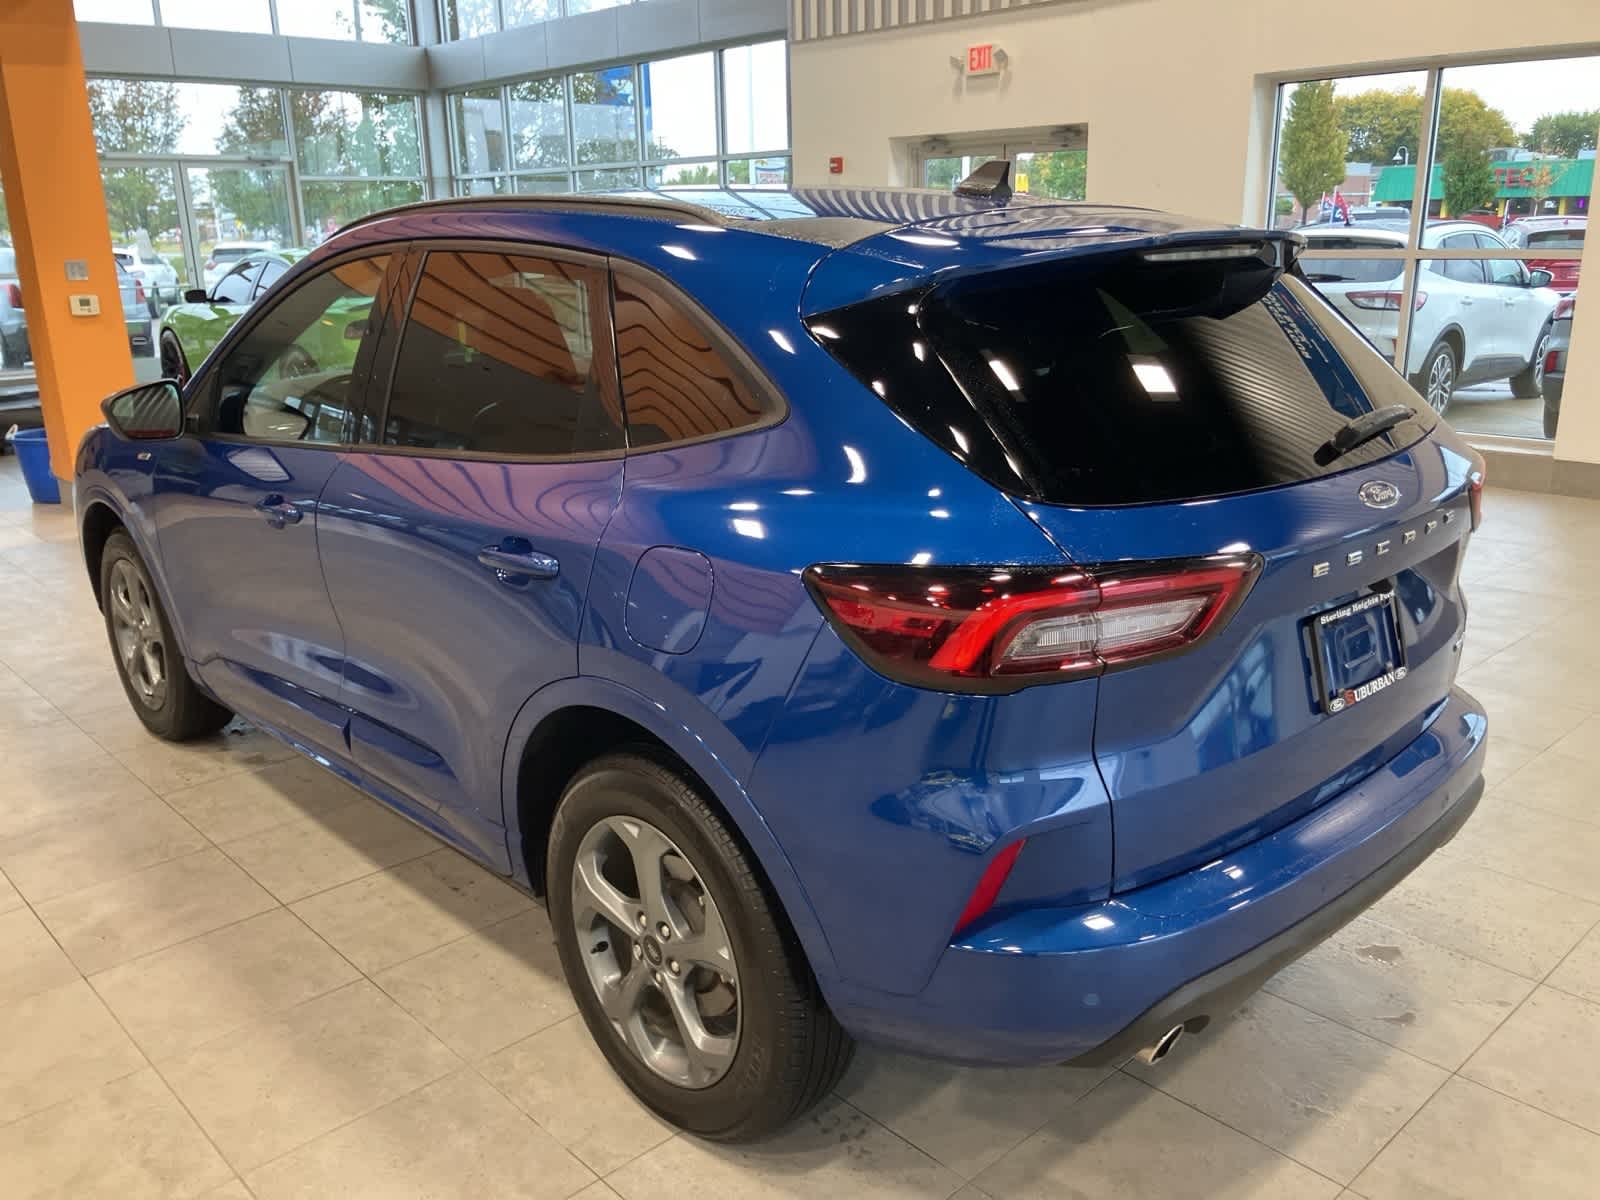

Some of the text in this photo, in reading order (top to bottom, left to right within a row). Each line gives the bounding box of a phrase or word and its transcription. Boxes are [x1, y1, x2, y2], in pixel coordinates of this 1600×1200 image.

[970, 46, 992, 71] EXIT
[1312, 510, 1455, 578] ESCAPE
[1320, 607, 1352, 625] Sterling
[1352, 597, 1379, 613] Heights
[1344, 671, 1395, 706] SUBURBAN
